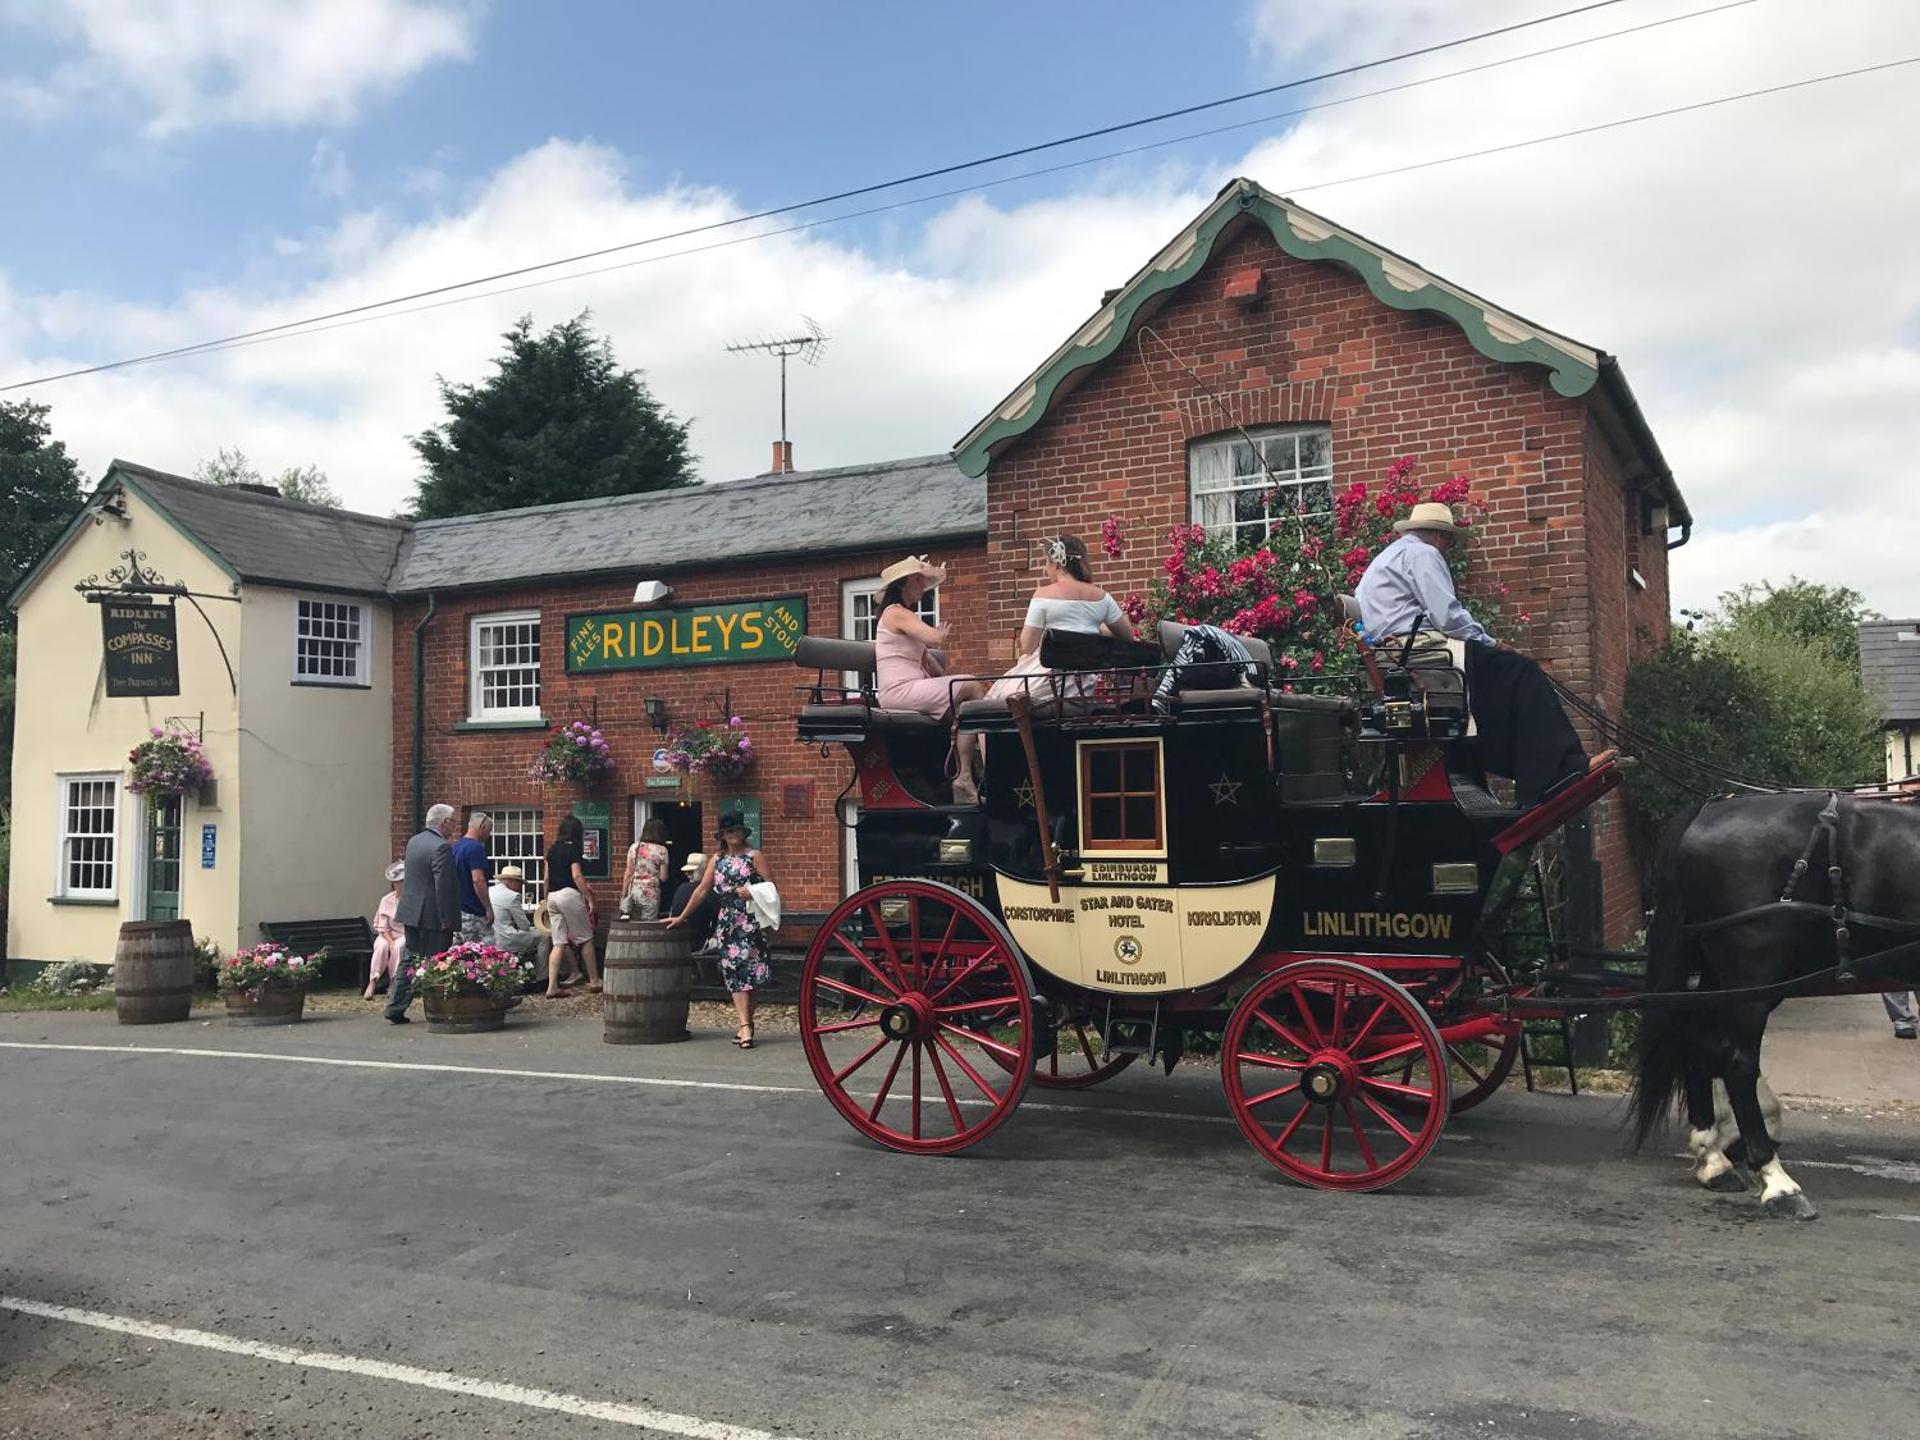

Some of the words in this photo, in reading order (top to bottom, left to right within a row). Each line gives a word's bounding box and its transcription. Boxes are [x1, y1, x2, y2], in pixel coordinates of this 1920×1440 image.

[110, 608, 167, 619] RIDLEYS
[775, 606, 799, 631] AND
[107, 632, 173, 651] COMPASSES
[571, 619, 595, 653] FINE
[603, 611, 763, 659] RIDLEYS
[576, 632, 601, 667] ALES
[131, 653, 153, 664] INN
[1091, 864, 1157, 873] EDINBURGH
[1092, 873, 1156, 881] LINLITHGOW
[1080, 896, 1109, 911] STAR
[1111, 896, 1134, 908] AND
[1004, 906, 1075, 923] CORSTORPHINE
[1108, 915, 1145, 928] HOTEL
[1187, 910, 1262, 926] KIRKLISTON
[1303, 911, 1453, 939] LINLITHGOW
[1096, 969, 1167, 985] LINLITHGOW
